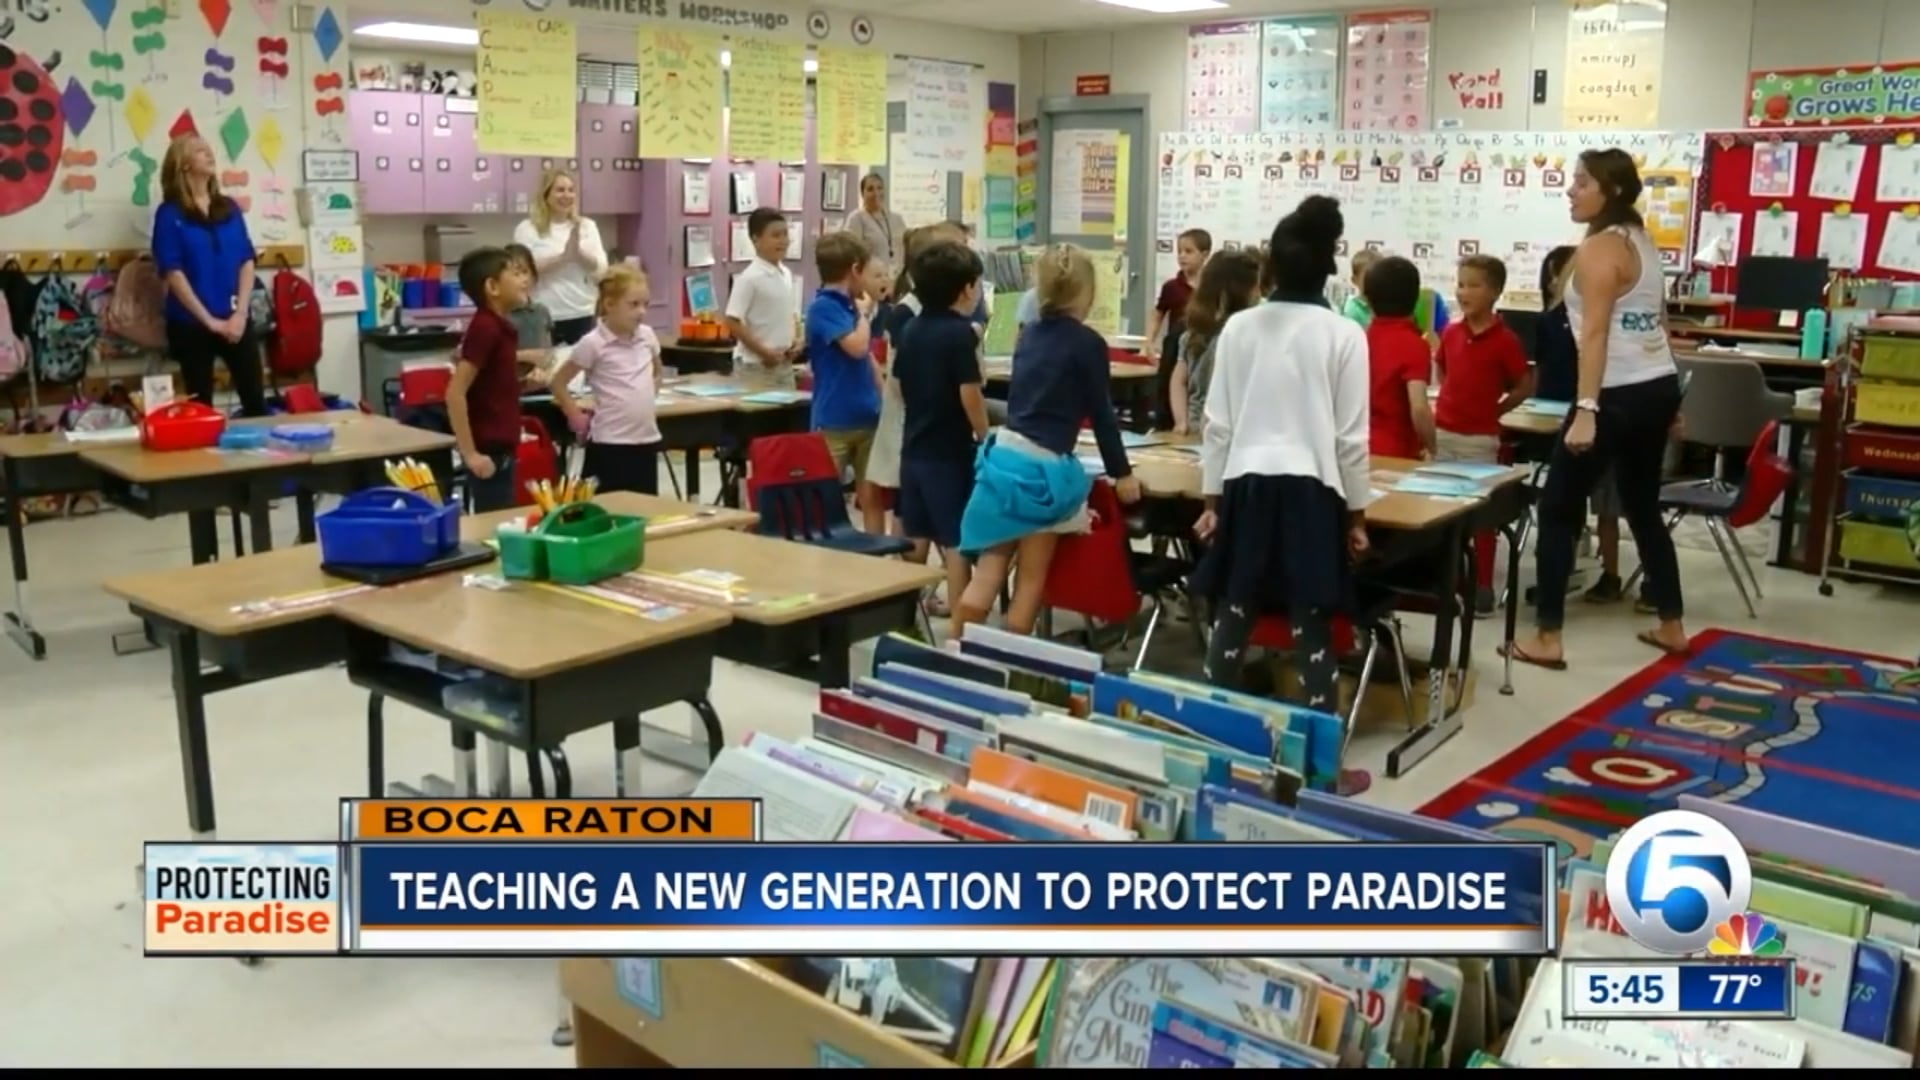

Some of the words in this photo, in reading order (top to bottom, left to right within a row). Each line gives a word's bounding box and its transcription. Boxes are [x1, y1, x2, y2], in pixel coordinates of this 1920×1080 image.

[1820, 77, 1873, 95] Great
[1796, 97, 1877, 117] Grows
[1591, 757, 1677, 785] Q
